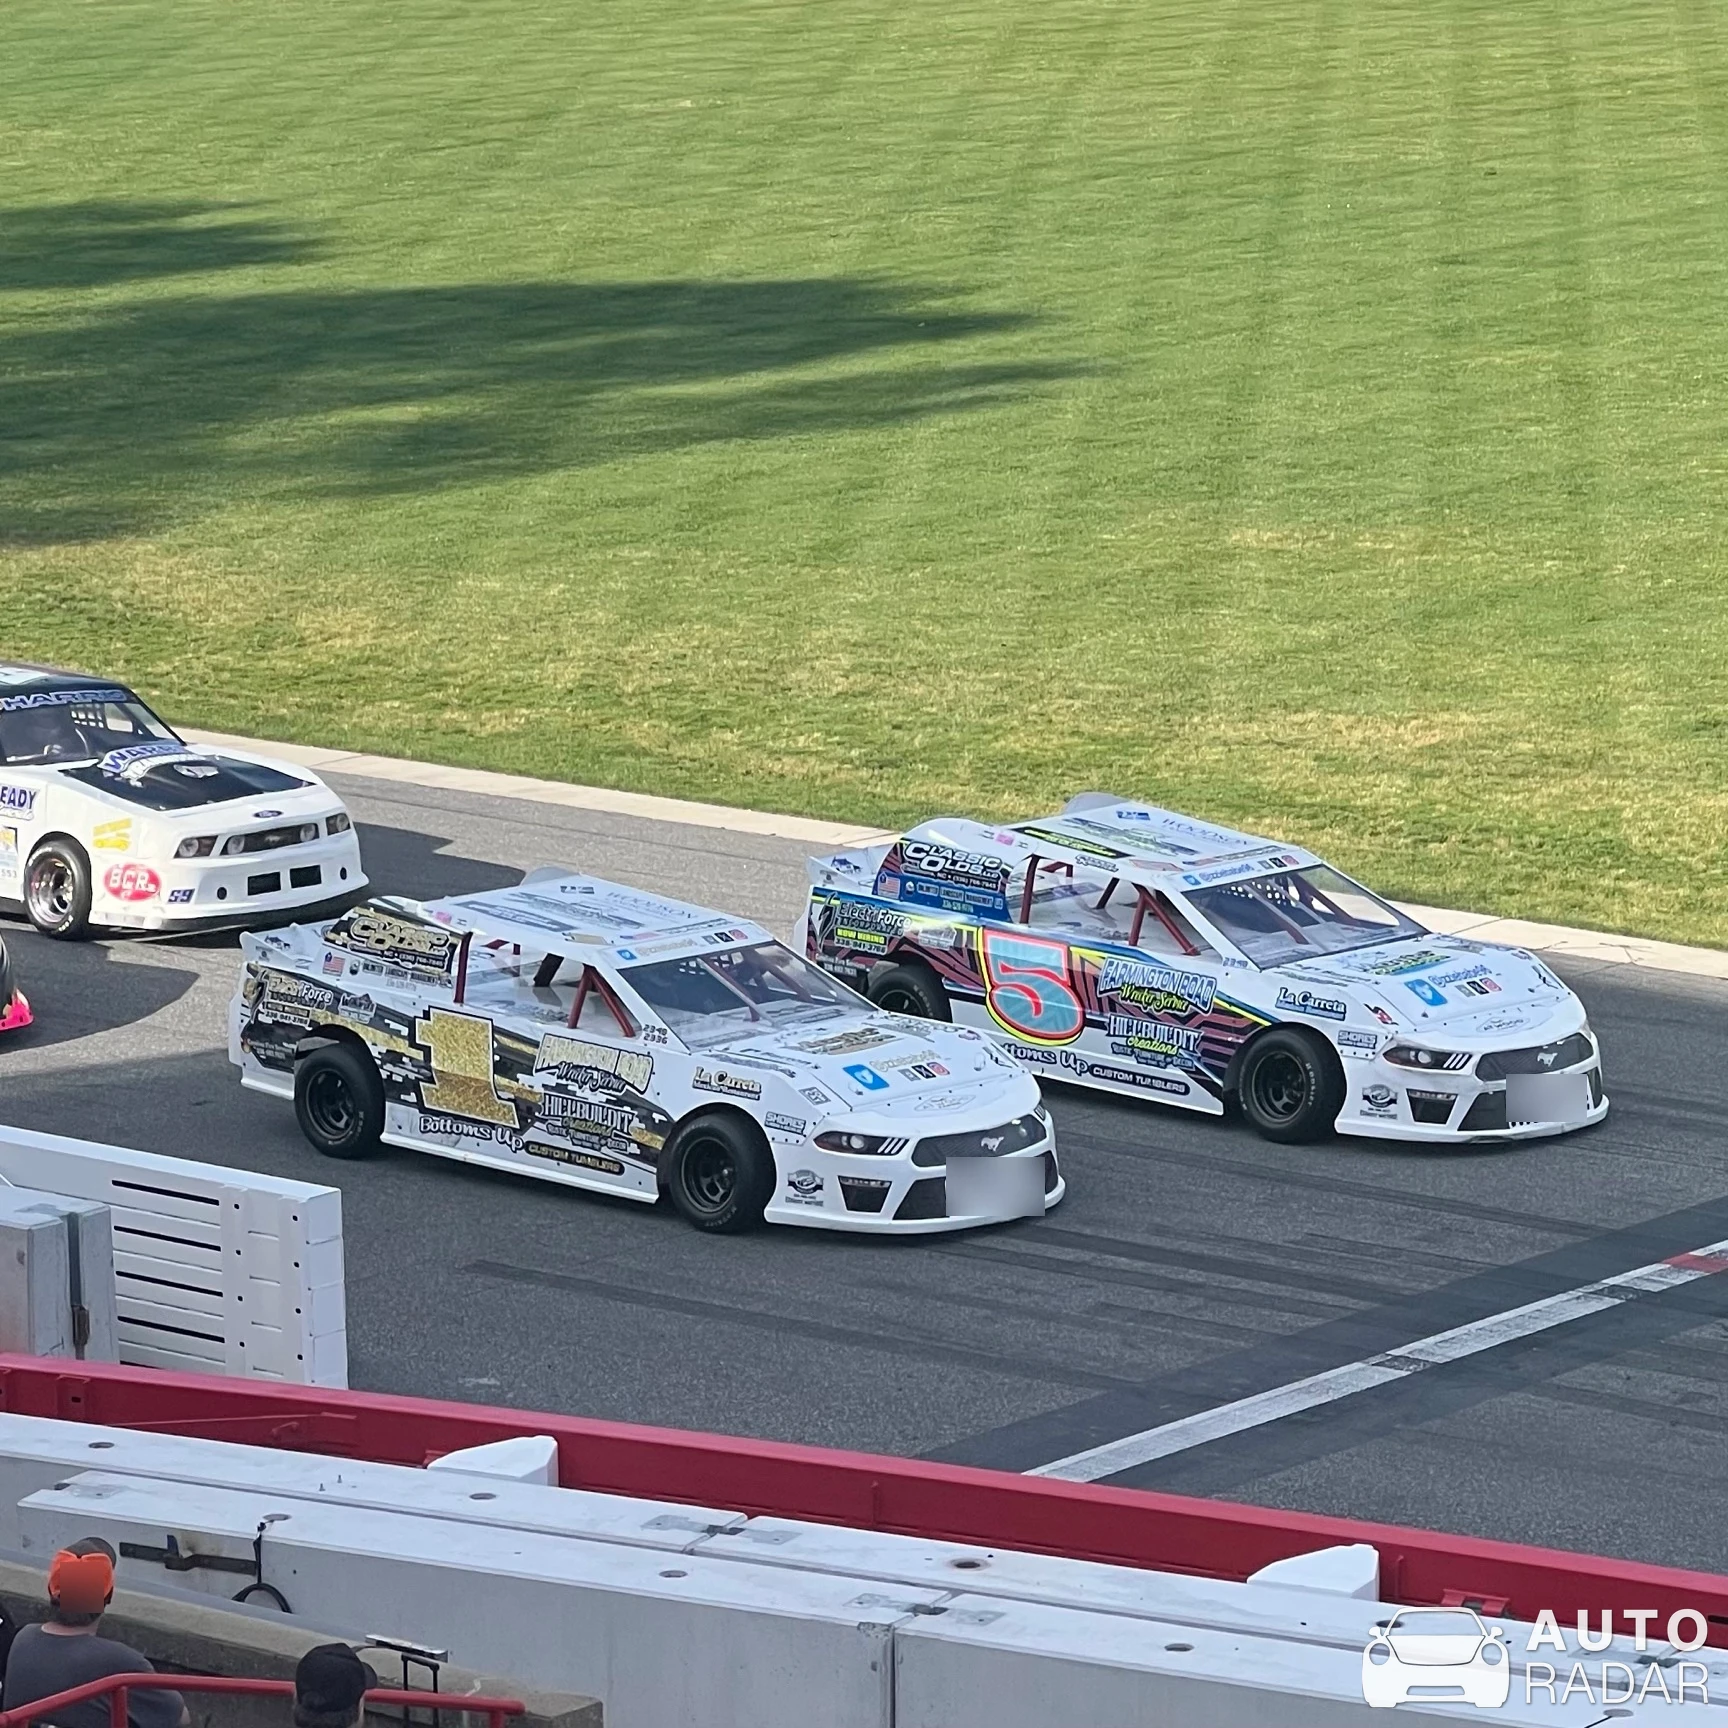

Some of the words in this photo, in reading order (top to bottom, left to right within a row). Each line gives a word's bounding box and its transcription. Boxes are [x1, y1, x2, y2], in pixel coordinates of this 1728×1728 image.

[905, 842, 1001, 868] CLASSIC
[920, 856, 983, 875] OLDS
[982, 929, 1086, 1044] 5
[1100, 959, 1181, 994] FARMINGTON
[1178, 974, 1214, 1011] ROAD
[1279, 988, 1294, 1002] La
[1298, 991, 1346, 1012] Carreta
[1339, 1031, 1376, 1044] SHORES
[415, 1007, 519, 1128] 1
[696, 1066, 712, 1082] La
[1003, 1044, 1056, 1064] ttoms
[1060, 1051, 1088, 1077] Up
[1092, 1066, 1134, 1082] CUSTOM
[1135, 1076, 1186, 1093] TUMBLERS
[420, 1116, 491, 1140] Bottoms
[495, 1127, 524, 1152] Up
[528, 1143, 568, 1160] CUSTOM
